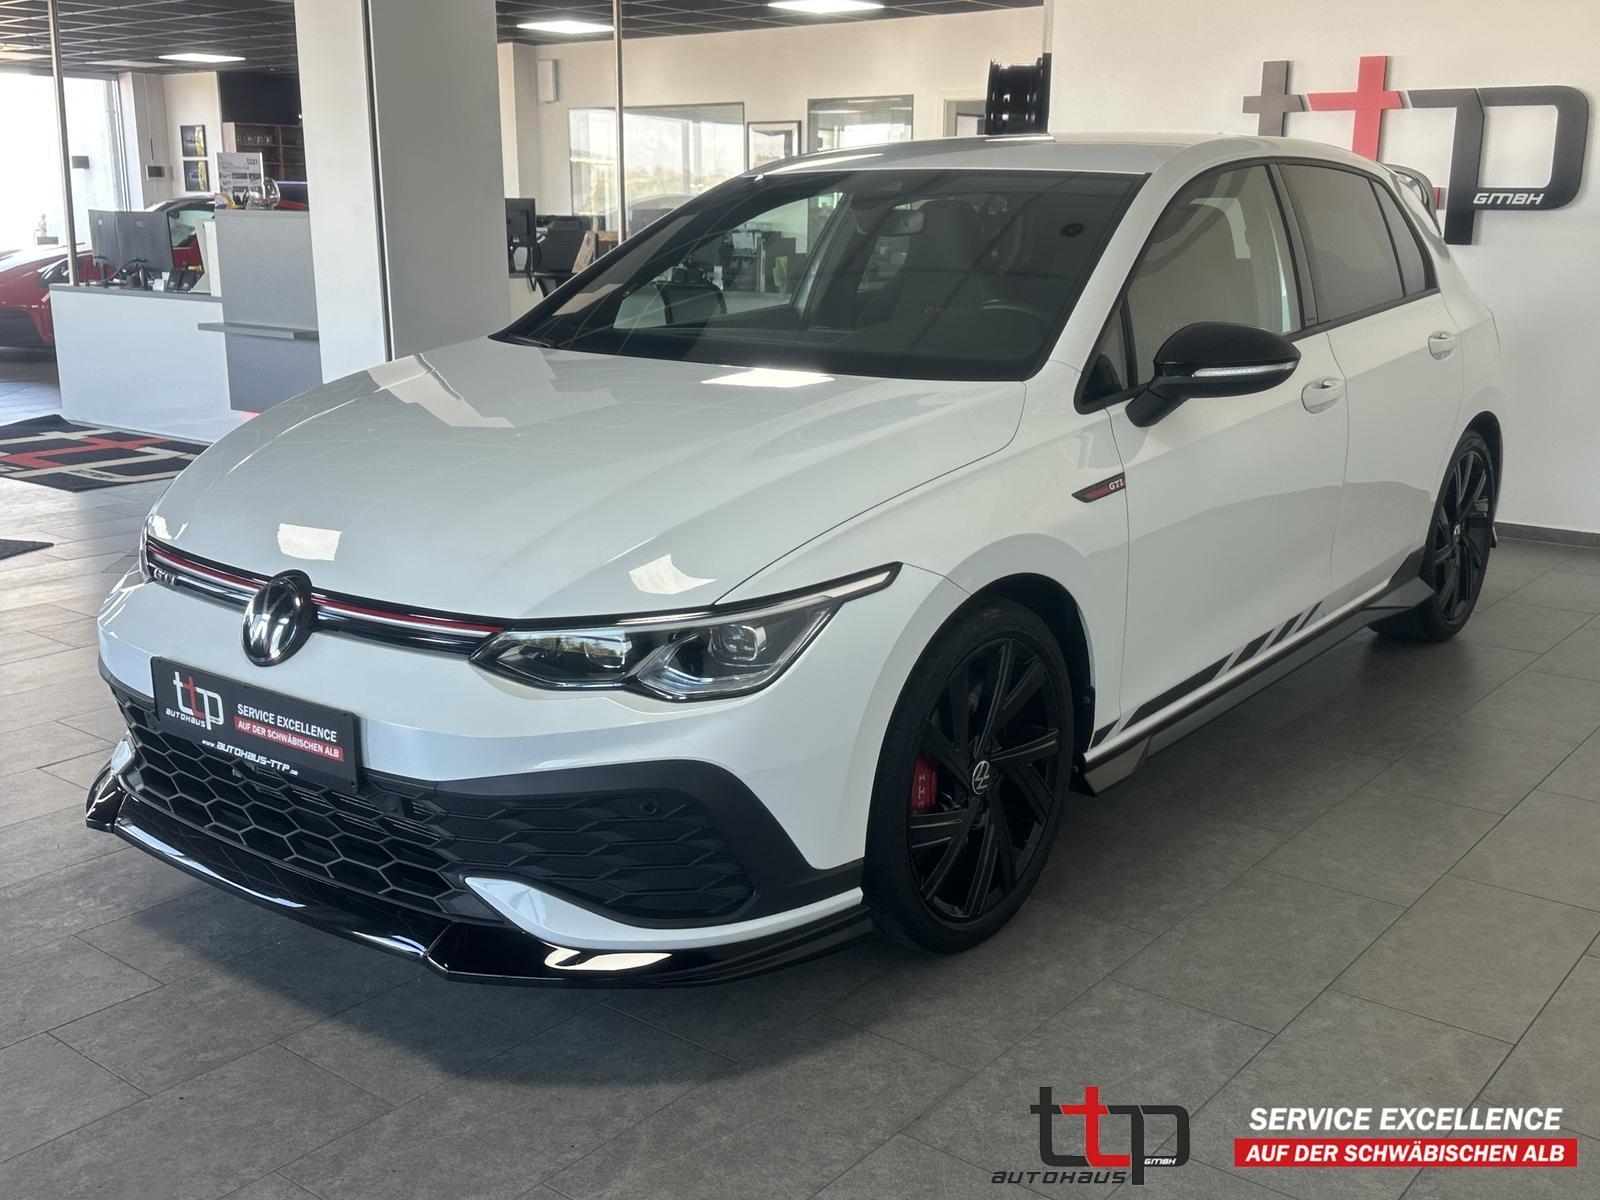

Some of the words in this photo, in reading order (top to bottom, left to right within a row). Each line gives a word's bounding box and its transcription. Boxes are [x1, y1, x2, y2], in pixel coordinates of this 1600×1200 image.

[1108, 478, 1124, 490] GTI
[173, 671, 225, 731] ttp
[237, 704, 275, 725] SERVICE
[276, 715, 337, 743] EXCELLENCE
[238, 720, 251, 733] AUF
[252, 723, 266, 738] DER
[267, 727, 324, 754] SCHWÄBISCHEN
[324, 747, 340, 758] ALB
